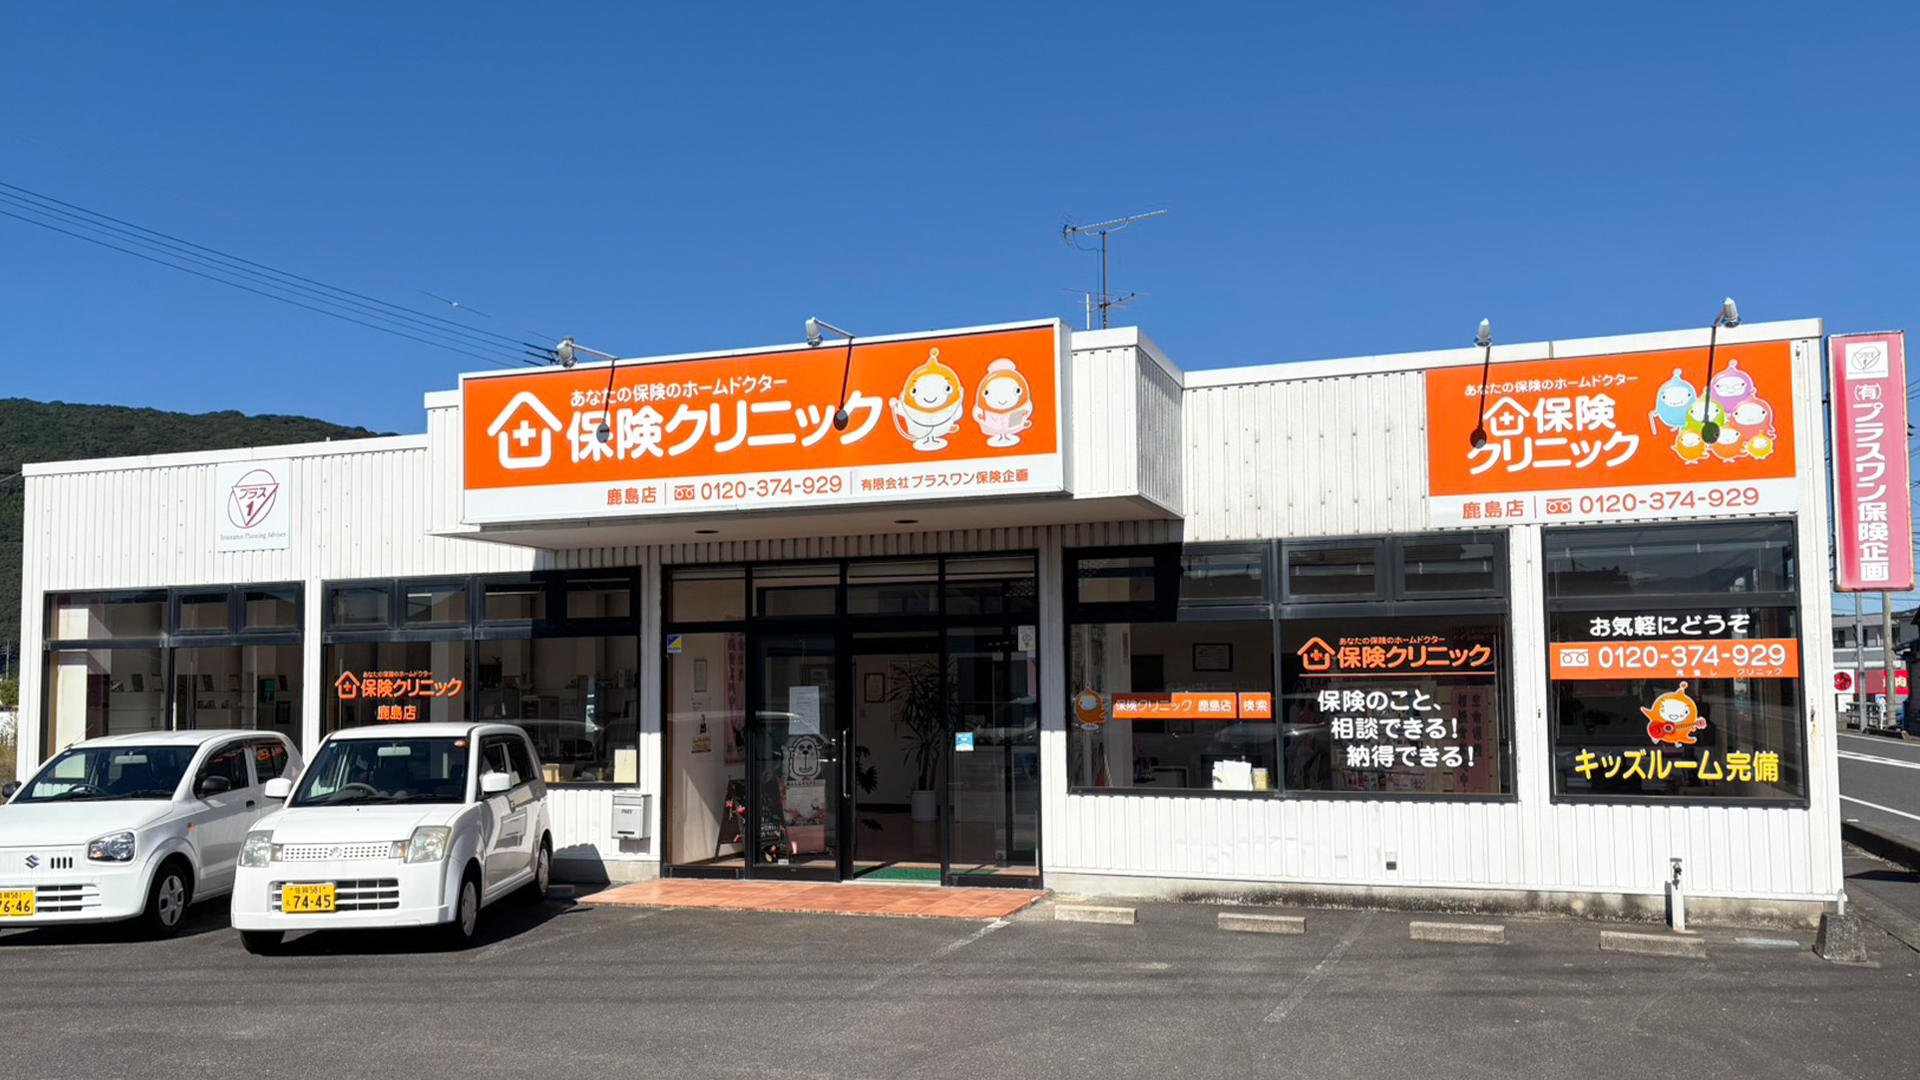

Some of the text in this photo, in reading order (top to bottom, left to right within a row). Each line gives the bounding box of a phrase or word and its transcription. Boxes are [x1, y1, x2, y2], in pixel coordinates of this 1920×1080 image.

[570, 374, 788, 407] あなたの保険のホームドクター
[1464, 373, 1639, 397] あなたの保険のホームドクター
[1532, 393, 1617, 434] 保険
[566, 391, 883, 463] 保険クリニック
[1467, 430, 1640, 475] クリニック
[607, 486, 657, 505] 鹿島店
[700, 475, 843, 500] 0120-374-929
[1462, 487, 1760, 519] 鹿島店 0120-374-929
[1588, 613, 1750, 638] お気軽にどうぞ
[1337, 643, 1492, 669] 保険クリニック
[1597, 643, 1786, 668] 0120-374-929
[360, 677, 463, 698] 保険クリニック
[1317, 688, 1441, 712] 保険のこと、
[377, 704, 417, 721] 鹿島店
[1115, 699, 1193, 712] 保険クリニック
[1331, 717, 1458, 740] 相談できる!
[1346, 744, 1475, 768] 納得できる!
[1574, 748, 1780, 783] キッズルーム完備
[293, 895, 332, 909] 74-45
